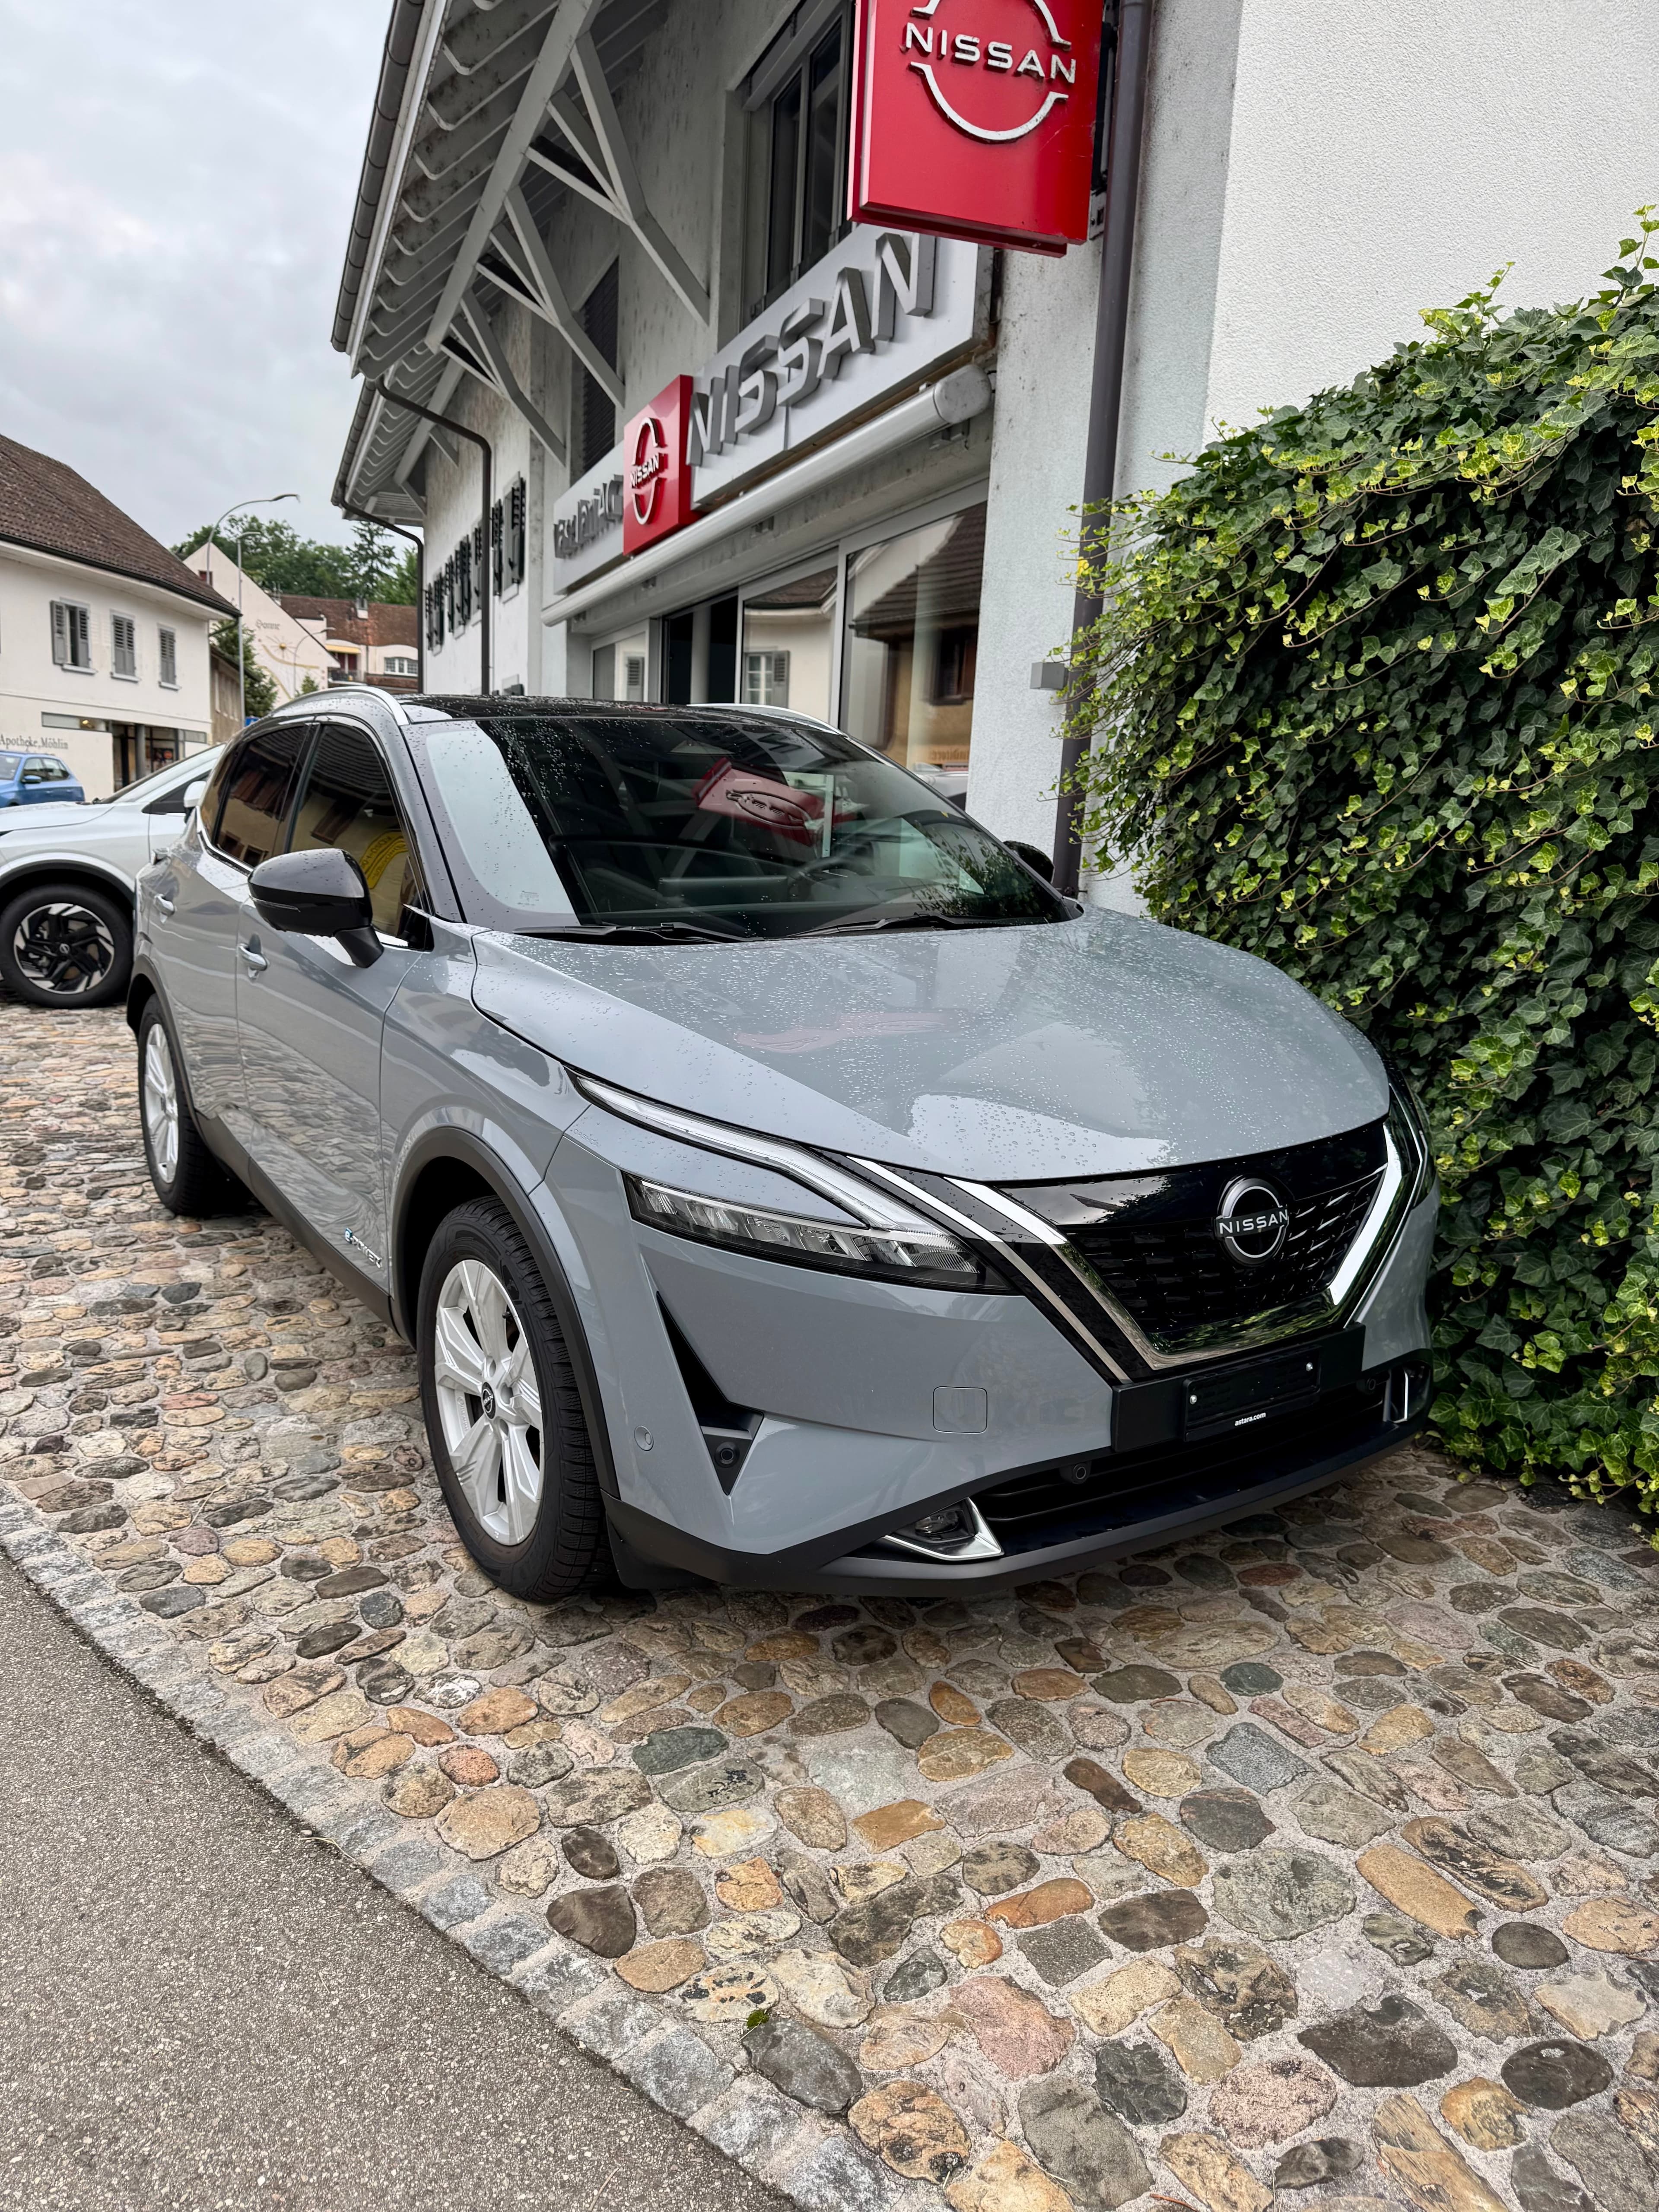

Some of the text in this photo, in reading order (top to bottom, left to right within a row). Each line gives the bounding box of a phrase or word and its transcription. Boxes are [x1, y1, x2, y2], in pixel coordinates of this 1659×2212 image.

[906, 22, 1076, 84] NISSAN
[686, 232, 936, 466] NISSAN
[629, 452, 659, 488] NISSAN
[1219, 1209, 1288, 1234] NISSAN
[1234, 1412, 1266, 1426] astara.com
